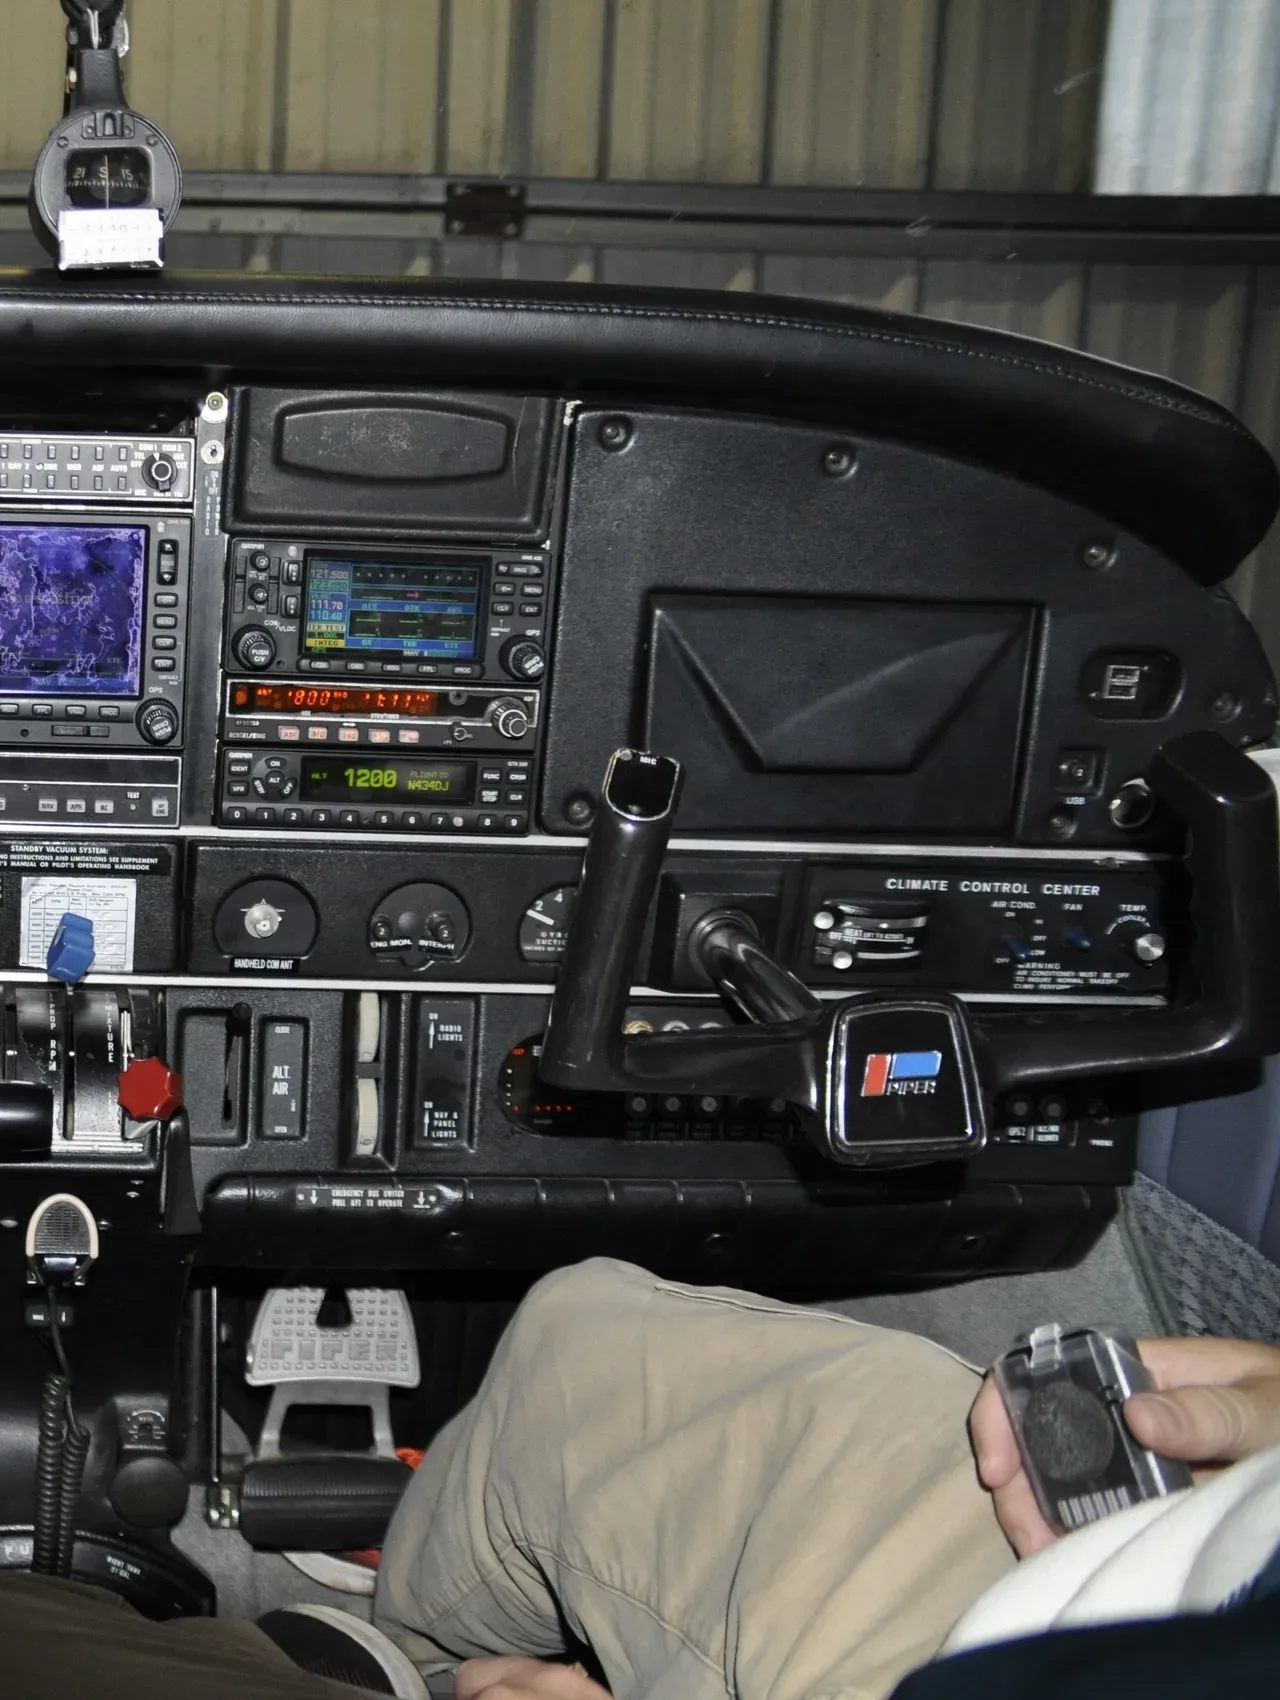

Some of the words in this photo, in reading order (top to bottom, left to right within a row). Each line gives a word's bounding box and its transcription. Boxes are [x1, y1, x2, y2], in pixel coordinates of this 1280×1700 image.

[74, 167, 85, 178] 21
[121, 169, 133, 181] 15
[92, 464, 104, 472] ADF
[311, 600, 343, 610] 111.70
[311, 611, 342, 621] 110.40
[640, 756, 657, 765] MIC
[344, 768, 397, 788] 1200
[254, 780, 266, 795] STBY
[283, 782, 294, 794] OFF
[408, 780, 450, 791] N434DJ
[1066, 797, 1085, 805] USB
[885, 878, 949, 891] CLIMATE
[959, 881, 1030, 894] CONTROL
[1042, 883, 1100, 896] CENTER
[1120, 904, 1148, 912] TEMP.
[419, 940, 455, 950] INTERPH
[234, 959, 266, 969] HANDHELD
[266, 960, 280, 969] COM
[280, 960, 293, 970] ANT
[439, 1024, 462, 1033] RADIO
[105, 1005, 114, 1063] MIXTURE
[437, 1034, 464, 1042] LIGHTS
[48, 1040, 57, 1071] RPM
[272, 1066, 291, 1079] ALT.
[273, 1082, 288, 1095] AIR
[886, 1080, 936, 1095] PIPER
[433, 1120, 456, 1128] PANEL
[431, 1130, 457, 1138] LIGHTS
[383, 1190, 404, 1198] SWITCH
[332, 1199, 346, 1207] PULL
[271, 1340, 398, 1361] PIPER
